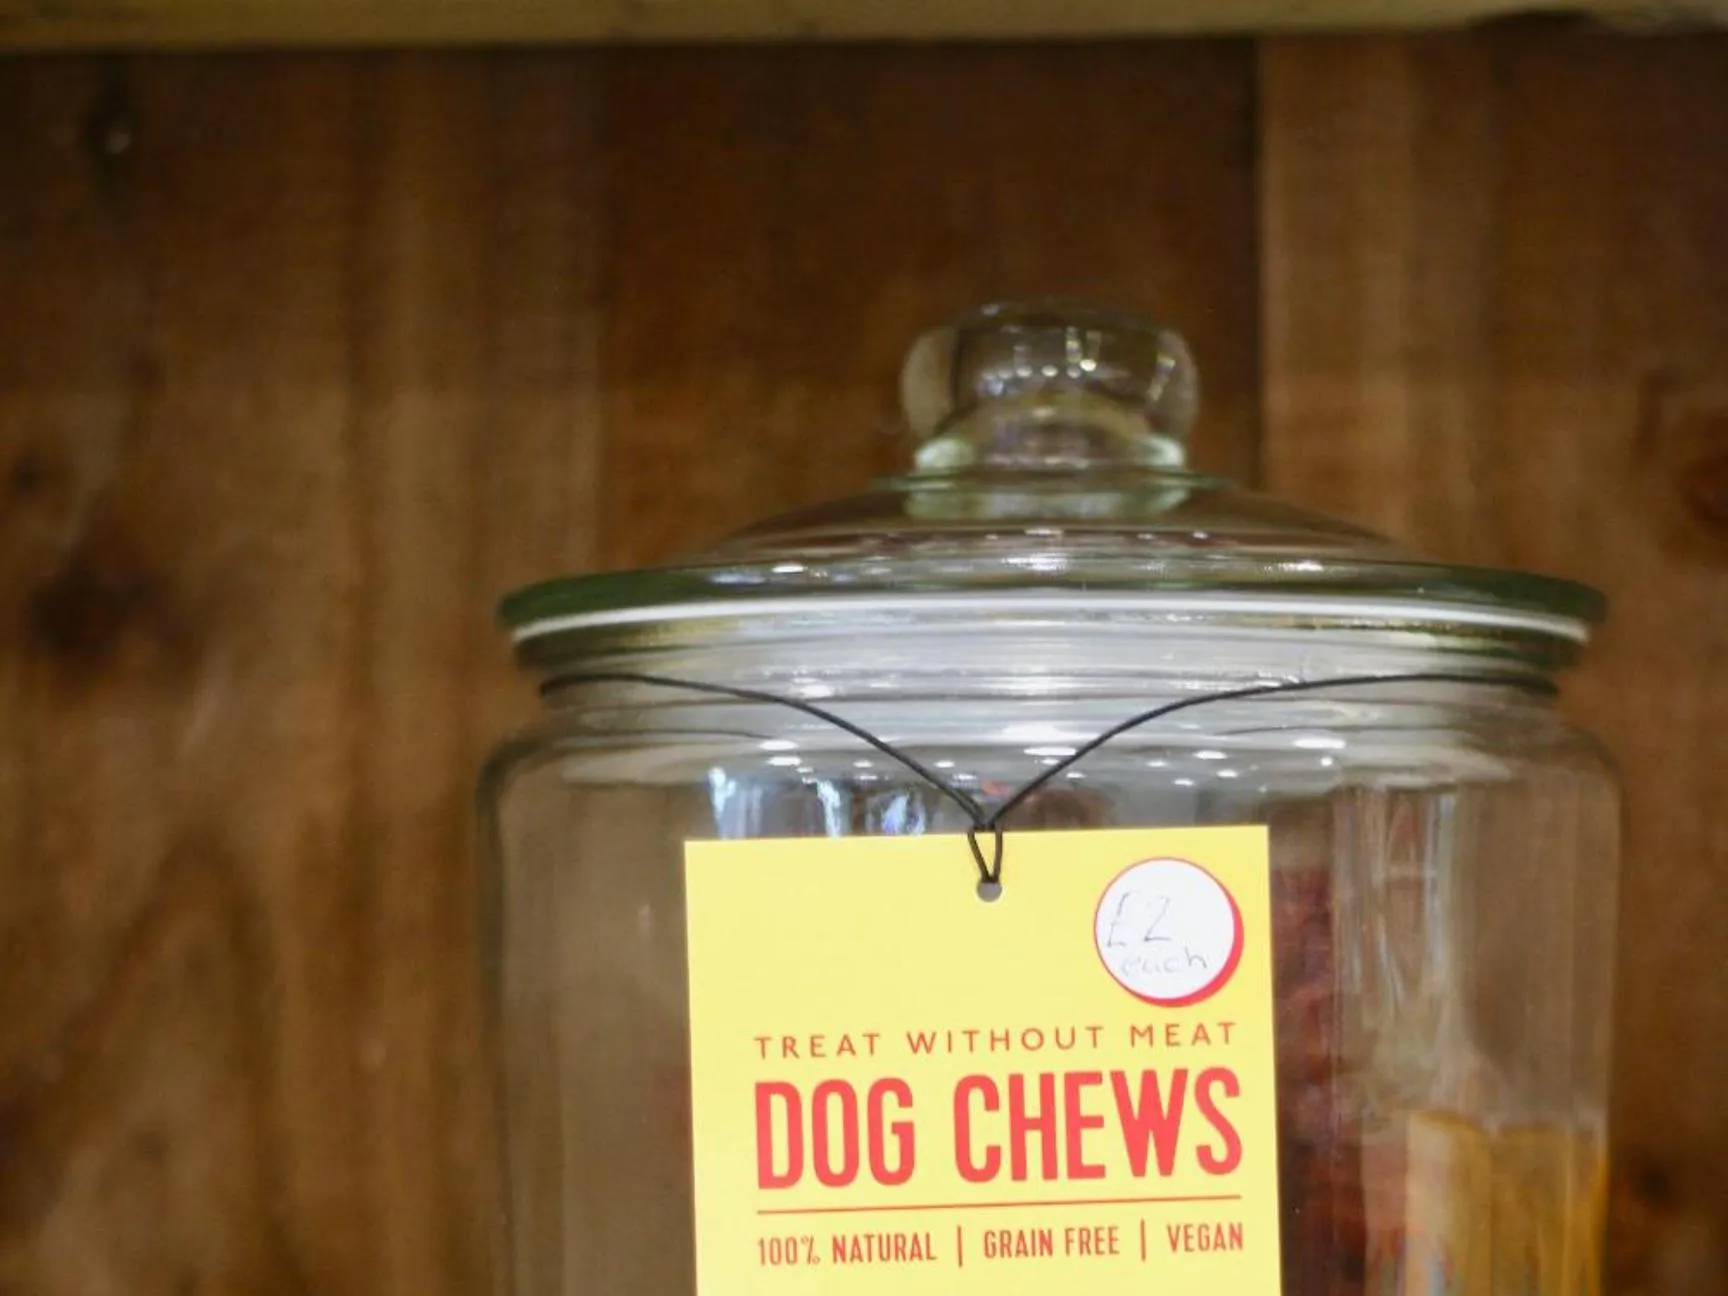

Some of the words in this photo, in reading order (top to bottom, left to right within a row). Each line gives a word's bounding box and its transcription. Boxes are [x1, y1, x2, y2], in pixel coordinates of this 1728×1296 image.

[755, 1033, 879, 1059] TREAT
[906, 1026, 1102, 1054] WITHOUT
[1130, 1022, 1234, 1048] MEAT
[755, 1078, 915, 1189] DOG
[953, 1067, 1242, 1183] CHEWS
[758, 1236, 820, 1265] 100%
[832, 1232, 936, 1264] NATURAL
[984, 1229, 1053, 1258] GRAIN
[1065, 1226, 1119, 1256] FREE
[1167, 1223, 1243, 1252] VEGAN
